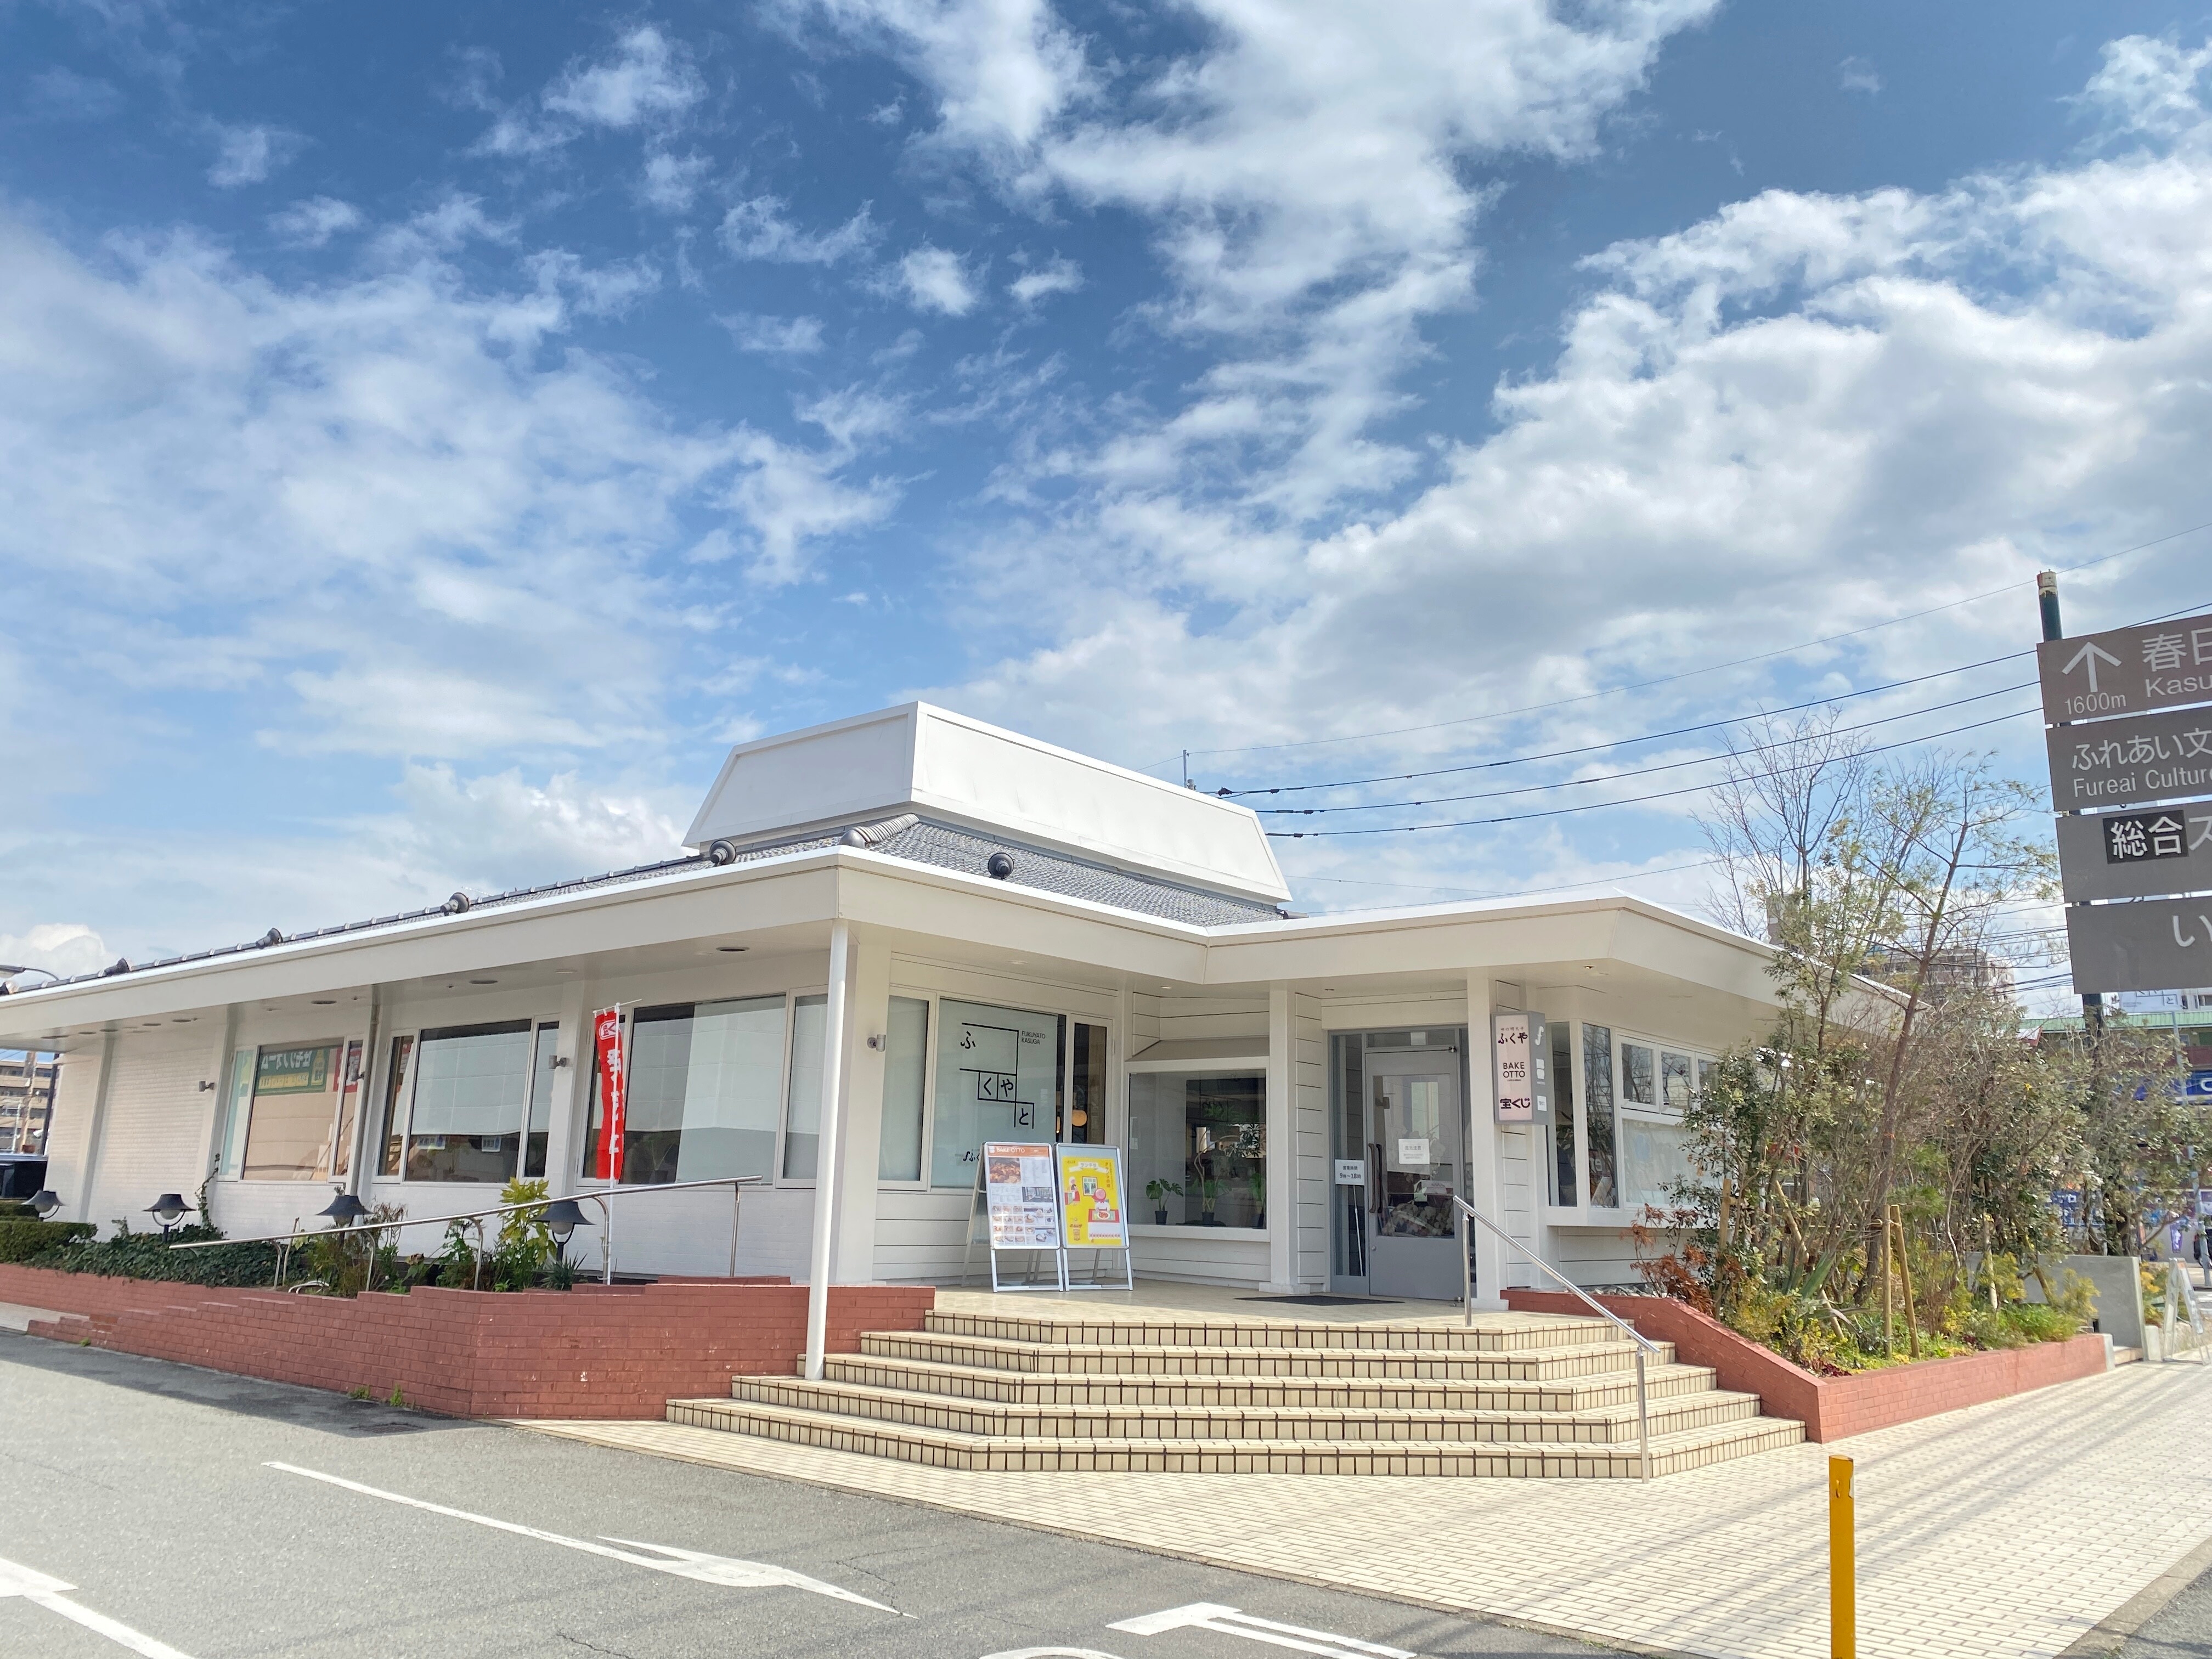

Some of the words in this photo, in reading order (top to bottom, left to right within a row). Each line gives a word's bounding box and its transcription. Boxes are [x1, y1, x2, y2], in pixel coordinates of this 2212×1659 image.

[2064, 692, 2126, 715] 1600m
[2072, 727, 2212, 771] ふれあい文
[2073, 771, 2136, 798] Fureai
[2145, 767, 2212, 789] Cultur
[1022, 1030, 1046, 1039] FUKUYATO
[1498, 1032, 1528, 1045] ふくや
[1503, 1062, 1525, 1070] BAKE
[1503, 1070, 1525, 1079] OTTO
[1500, 1098, 1530, 1109] 宝くじ
